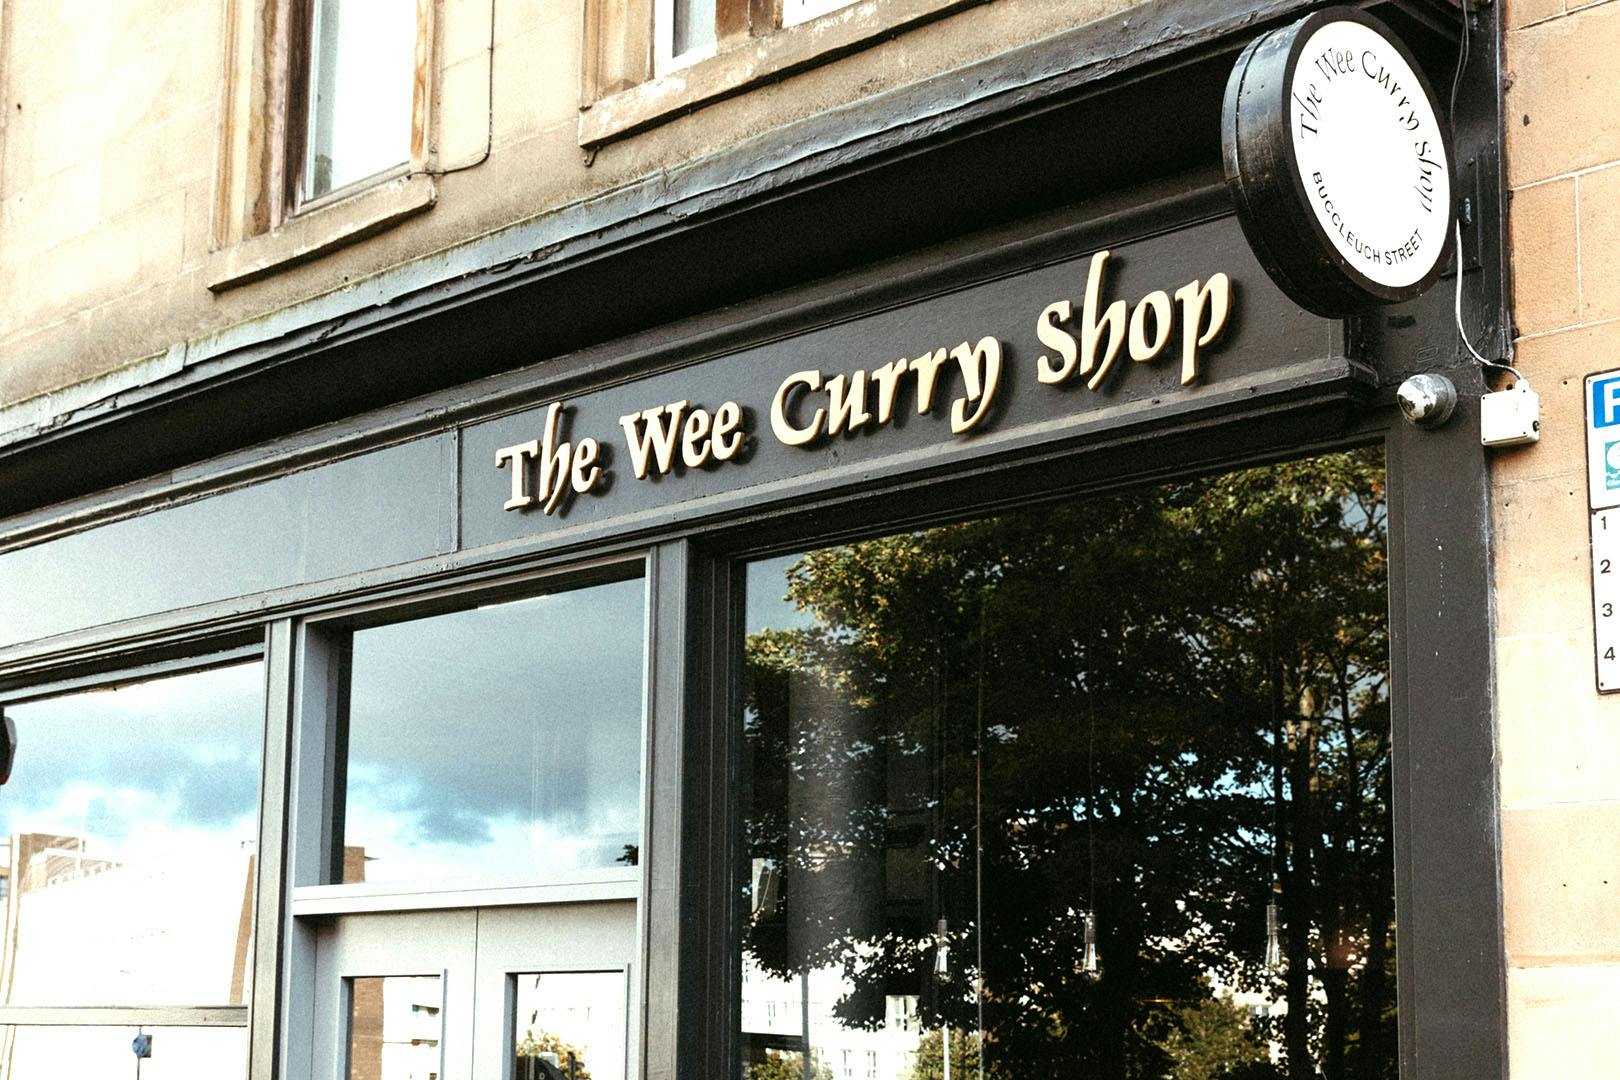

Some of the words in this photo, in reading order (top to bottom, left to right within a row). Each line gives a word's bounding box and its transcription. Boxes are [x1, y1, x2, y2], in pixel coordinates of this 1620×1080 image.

[1293, 83, 1323, 139] The
[1315, 48, 1356, 82] Wee
[1361, 50, 1420, 131] Curry
[1312, 171, 1381, 264] BUCCLEUCH
[1384, 228, 1423, 266] STREET
[494, 401, 600, 516] The
[618, 399, 744, 479] Wee
[770, 335, 1004, 446] Curry
[1600, 516, 1607, 530] 1
[1600, 559, 1611, 574] 2
[1602, 602, 1613, 618] 3
[1603, 646, 1616, 661] 4
